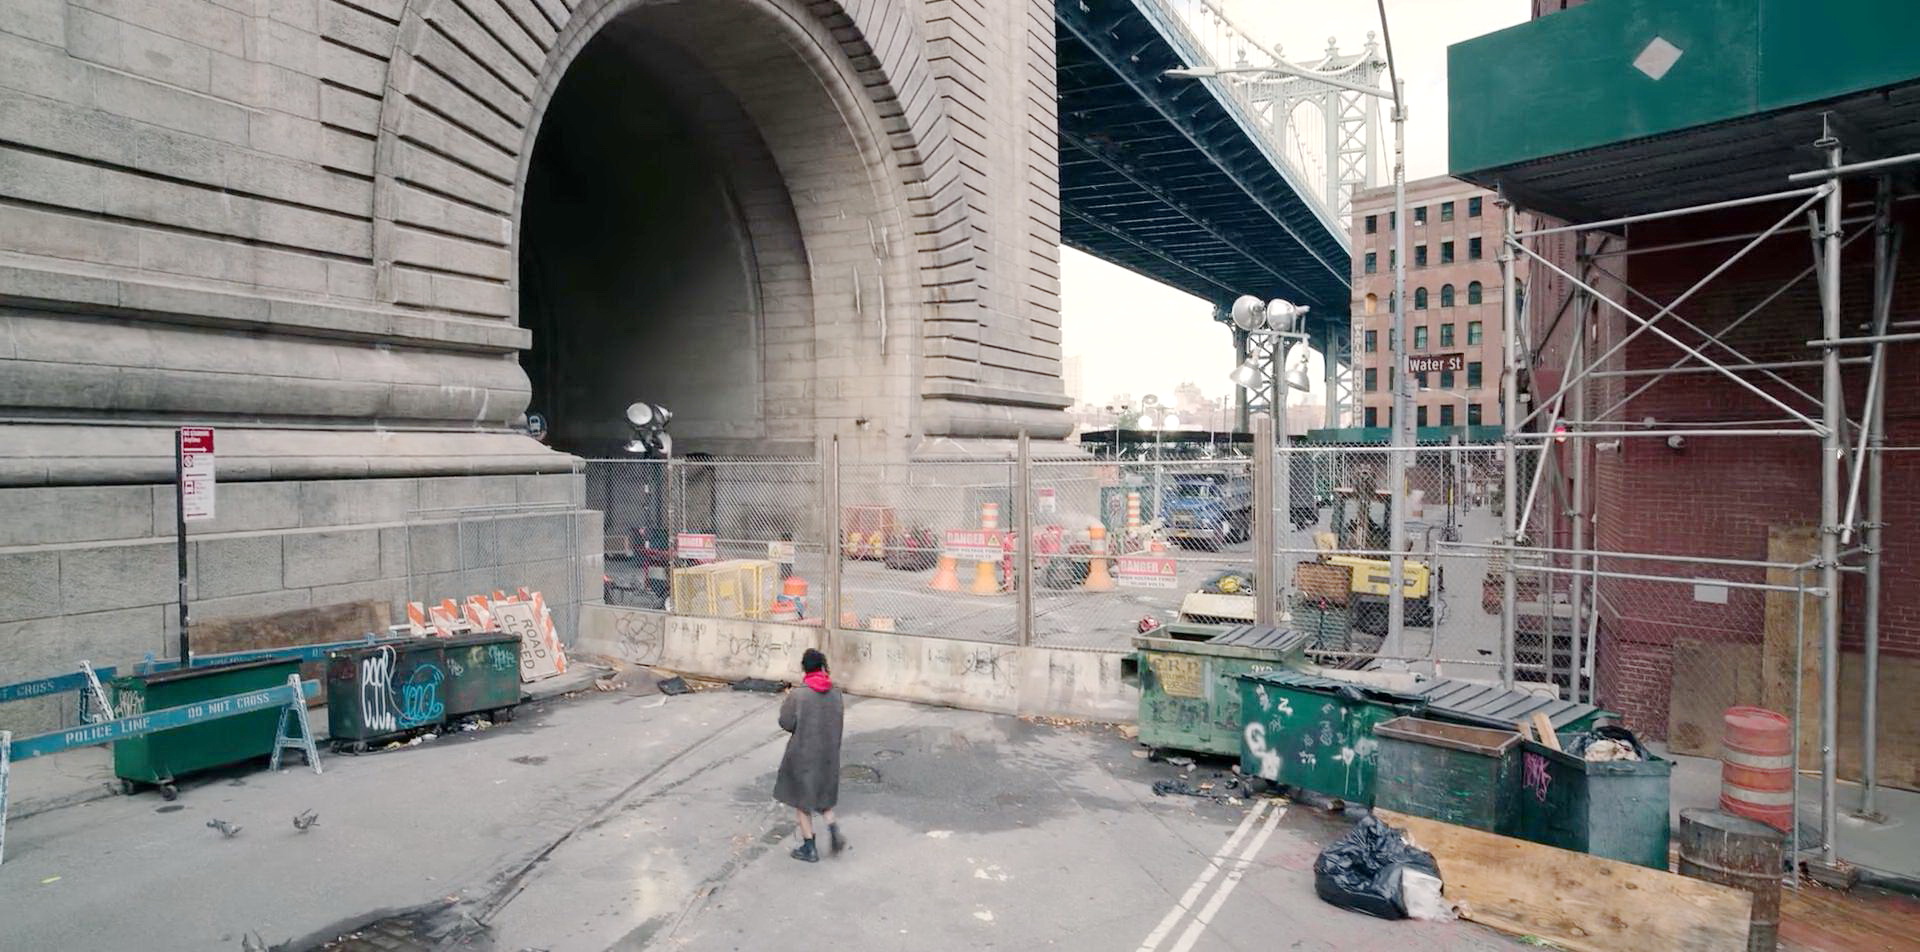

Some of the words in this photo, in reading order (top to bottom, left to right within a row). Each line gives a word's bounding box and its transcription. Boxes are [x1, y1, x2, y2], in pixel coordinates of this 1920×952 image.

[1410, 358, 1445, 371] Water
[1449, 357, 1461, 370] St
[945, 532, 984, 544] DANGER
[1120, 560, 1158, 573] DANGER
[521, 618, 546, 659] ROAD
[16, 680, 55, 697] CROSS
[65, 726, 113, 744] POLICE
[121, 718, 151, 734] LINE
[188, 707, 202, 719] DO
[209, 701, 231, 714] NOT
[236, 692, 270, 709] CROSS
